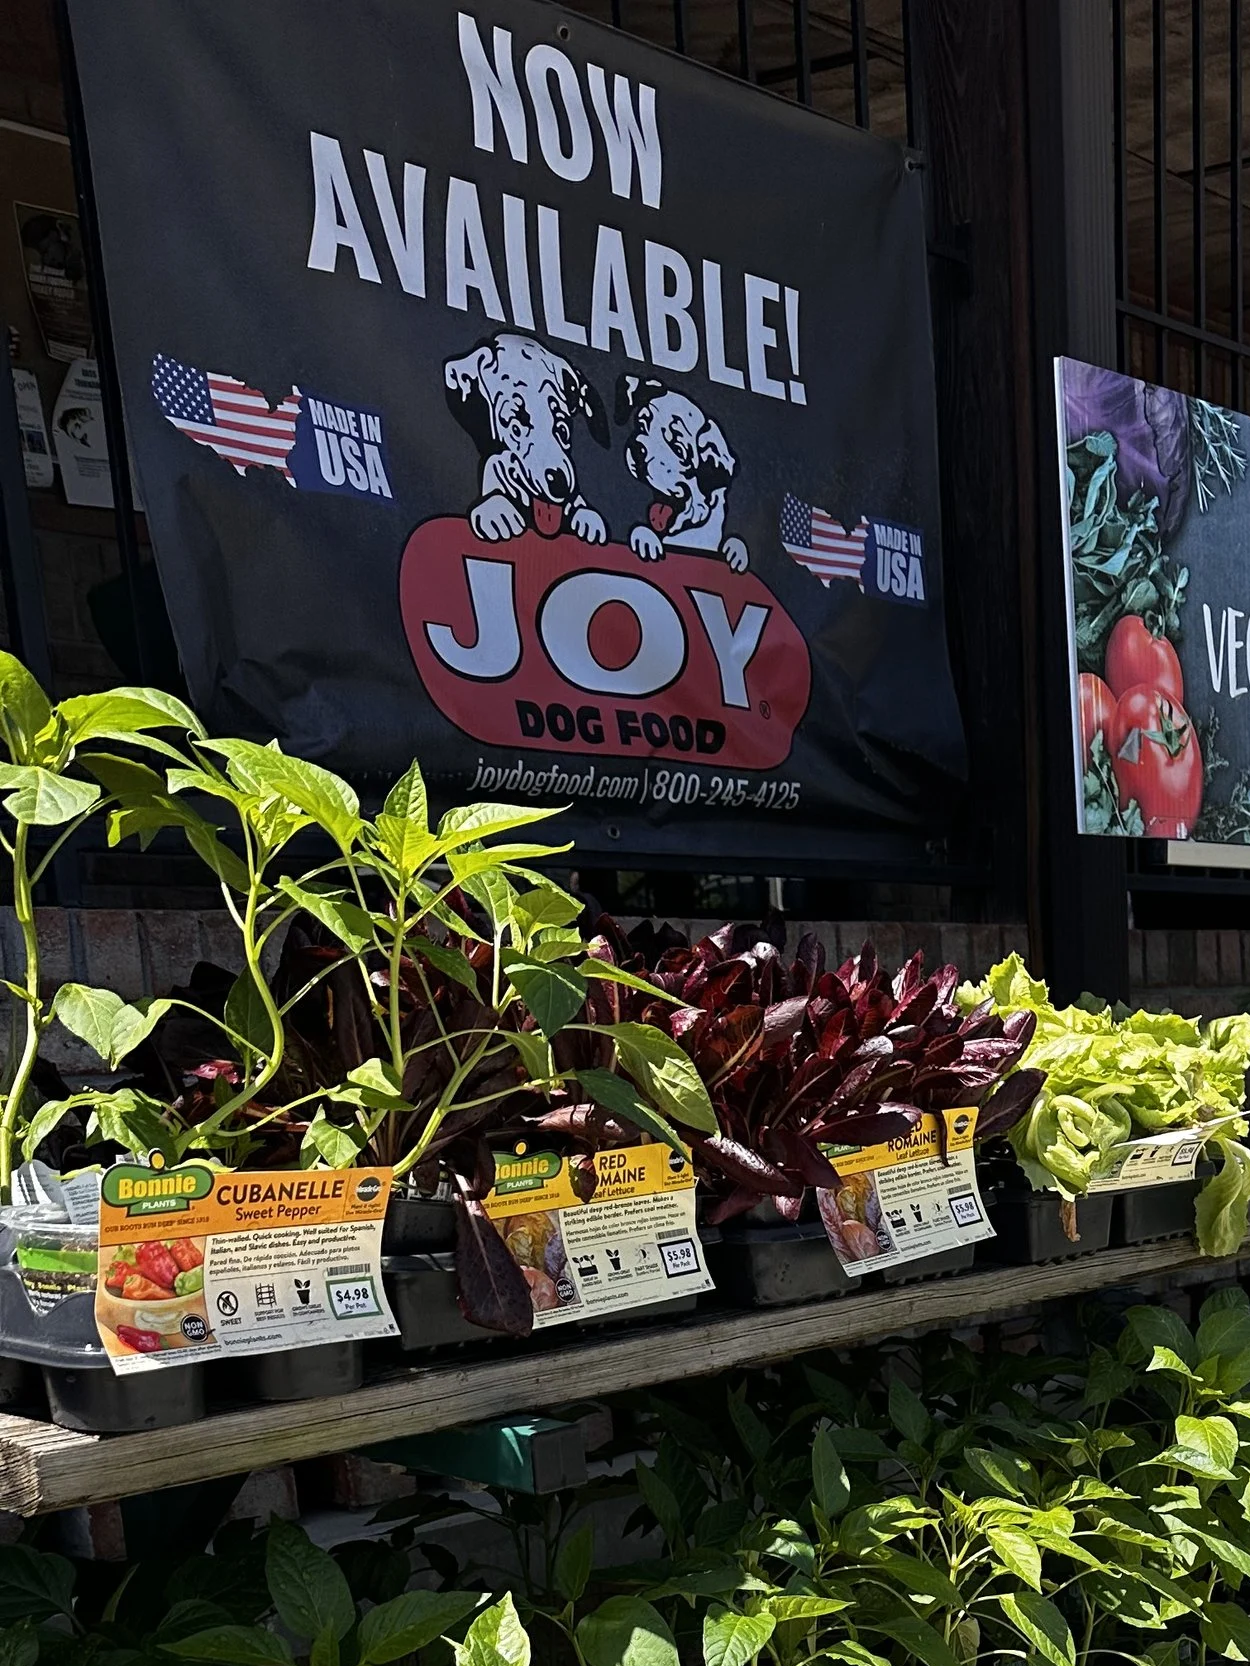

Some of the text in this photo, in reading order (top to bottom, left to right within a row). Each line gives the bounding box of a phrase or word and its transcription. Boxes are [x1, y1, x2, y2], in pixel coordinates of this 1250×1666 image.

[457, 11, 662, 210] NOW
[307, 130, 807, 406] AVAILABLE!
[308, 398, 382, 444] MADE IN
[314, 428, 392, 498] USA
[874, 523, 922, 557] MADE IN
[876, 547, 925, 600] USA
[425, 558, 771, 710] JOY
[515, 699, 726, 755] DOG FOOD
[466, 758, 800, 811] joydogfood.com 800-245-4125
[888, 1130, 936, 1153] ROMAINE
[599, 1154, 626, 1171] RED
[119, 1174, 196, 1200] Bonnie
[506, 1179, 534, 1188] PLANTS
[607, 1185, 635, 1197] Lettuce
[217, 1180, 344, 1206] CUBANELLE
[142, 1200, 176, 1210] PLANTS
[236, 1204, 322, 1222] Sweet Pepper
[955, 1201, 974, 1214] $5.98
[252, 1233, 272, 1241] Quick
[248, 1242, 267, 1251] Slavic
[667, 1248, 691, 1262] $5.98
[336, 1288, 369, 1303] $4.98
[557, 1285, 572, 1293] NON
[184, 1321, 203, 1331] NON
[221, 1319, 242, 1327] SWEET
